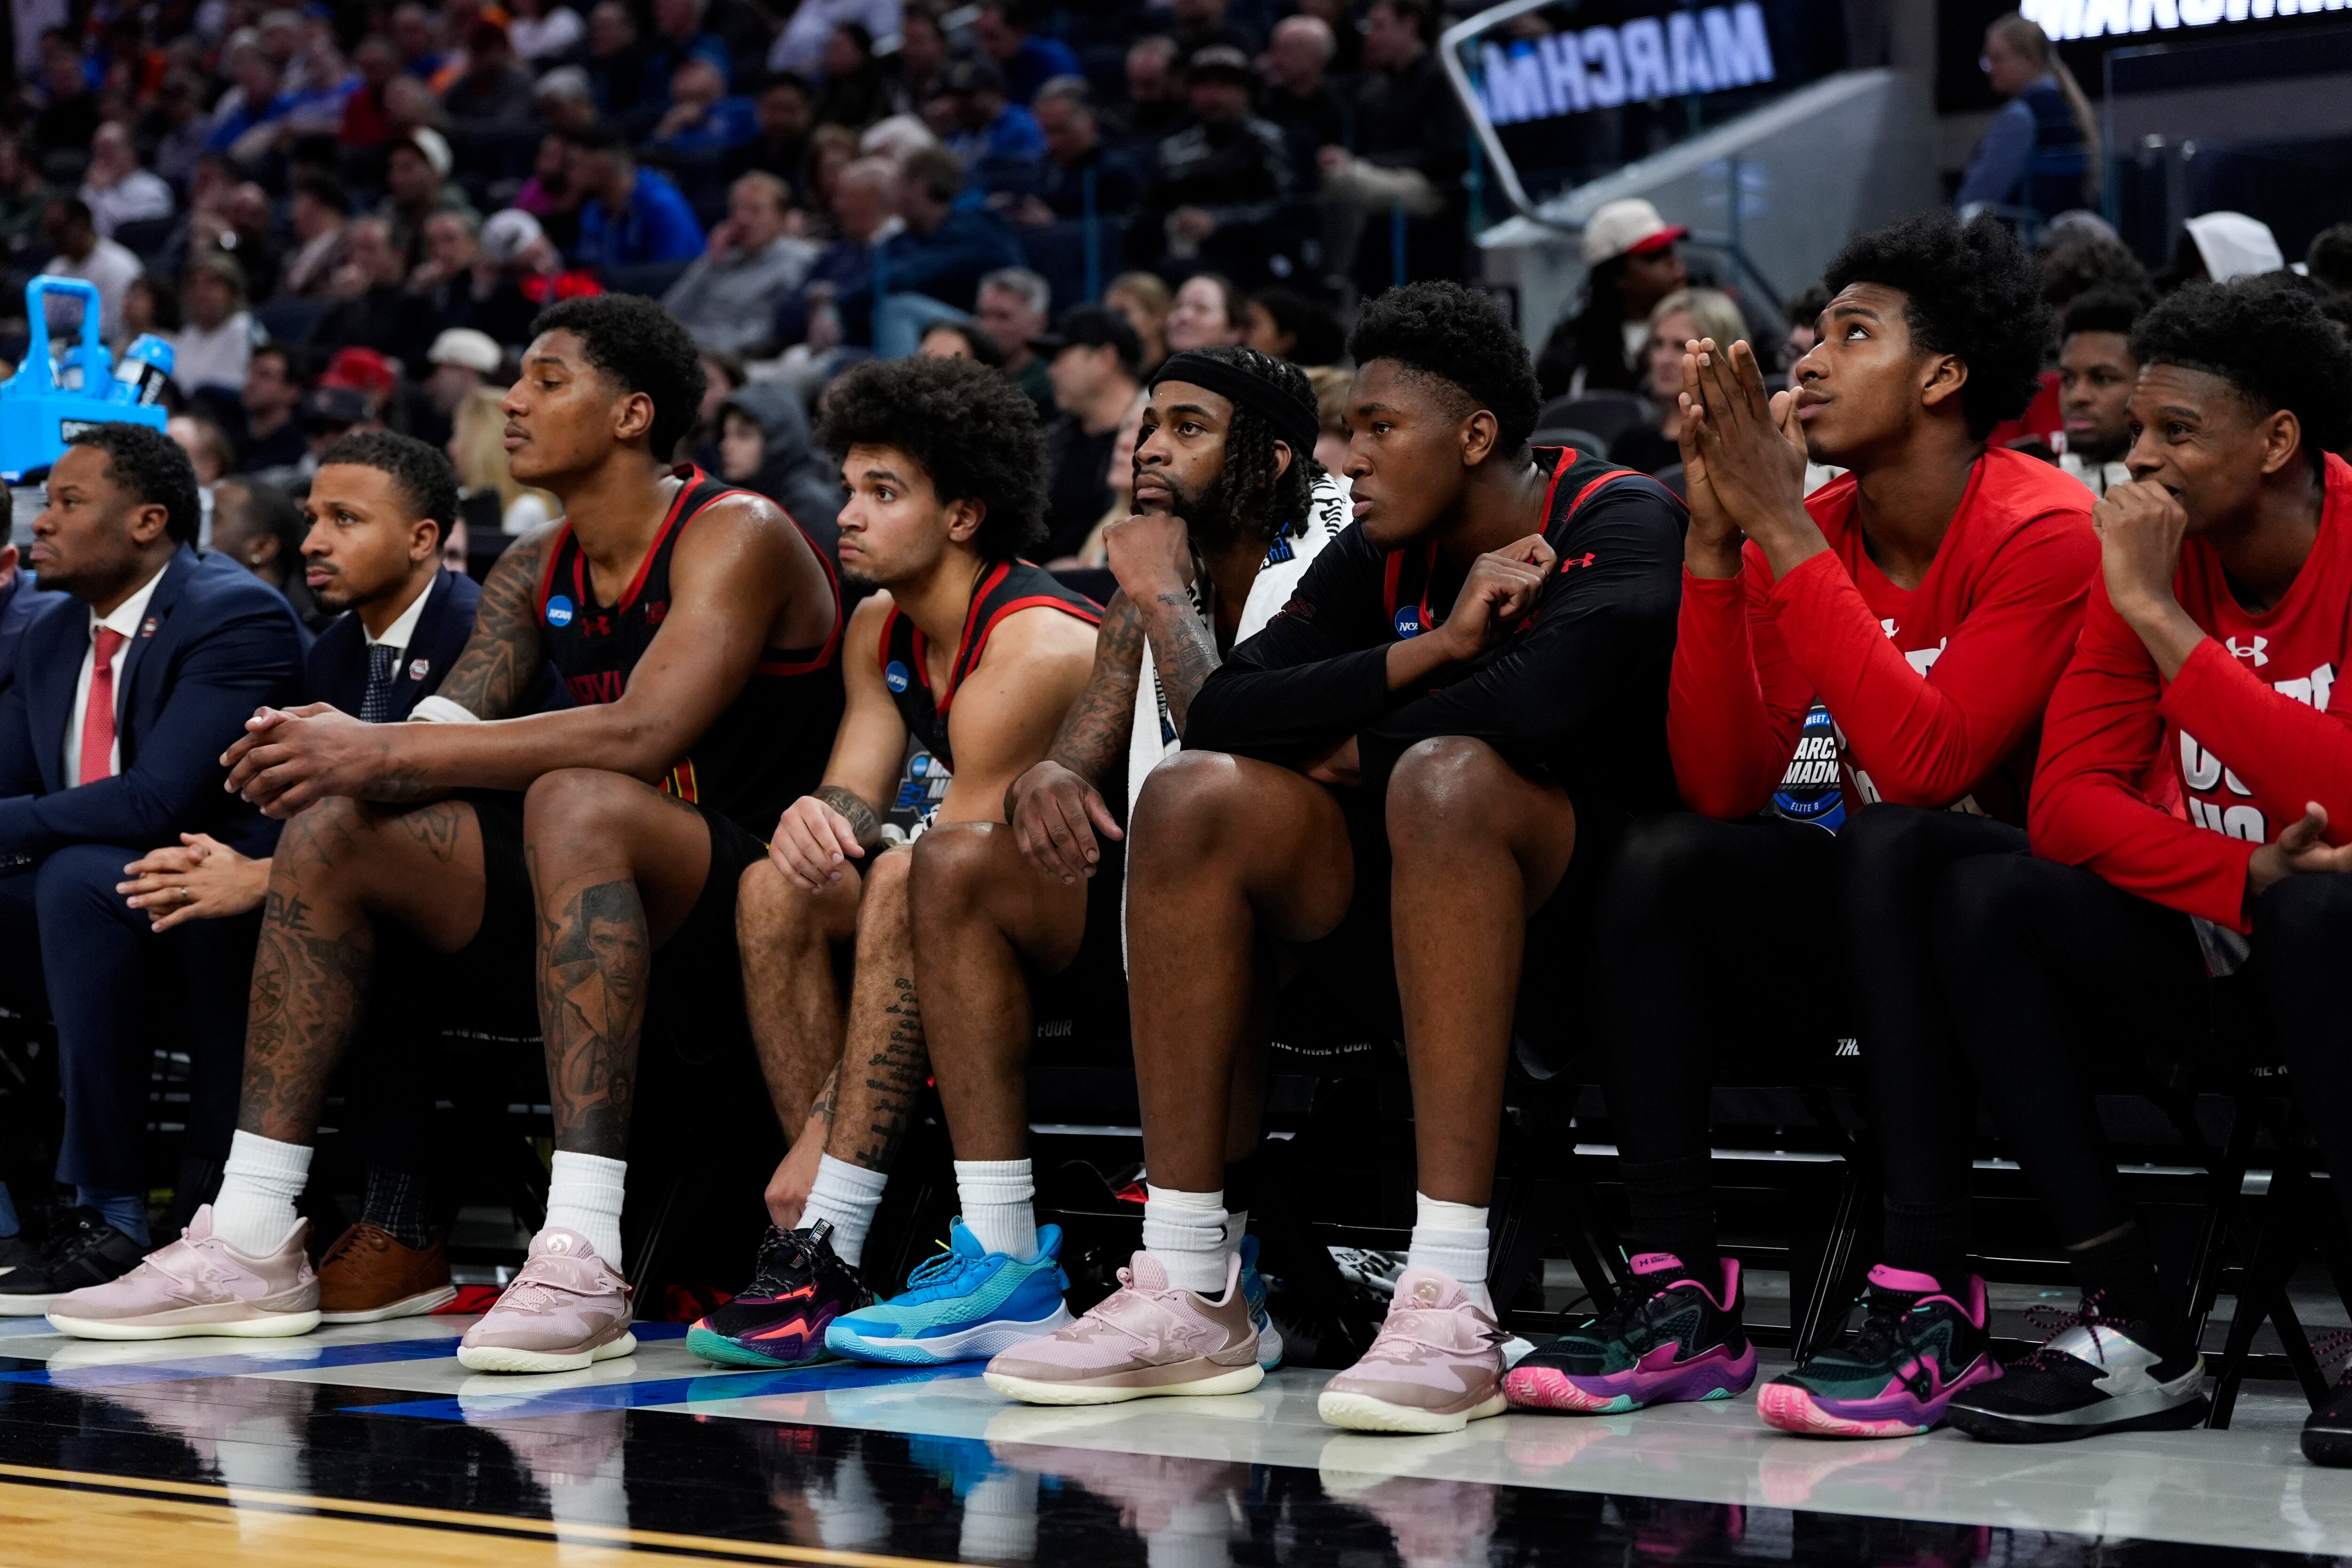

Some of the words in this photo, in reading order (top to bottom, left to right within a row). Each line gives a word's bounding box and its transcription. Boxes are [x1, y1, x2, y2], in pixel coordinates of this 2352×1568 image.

[1804, 714, 1826, 727] WEET
[1790, 802, 1811, 812] ELITE
[1037, 1020, 1073, 1037] FOUR
